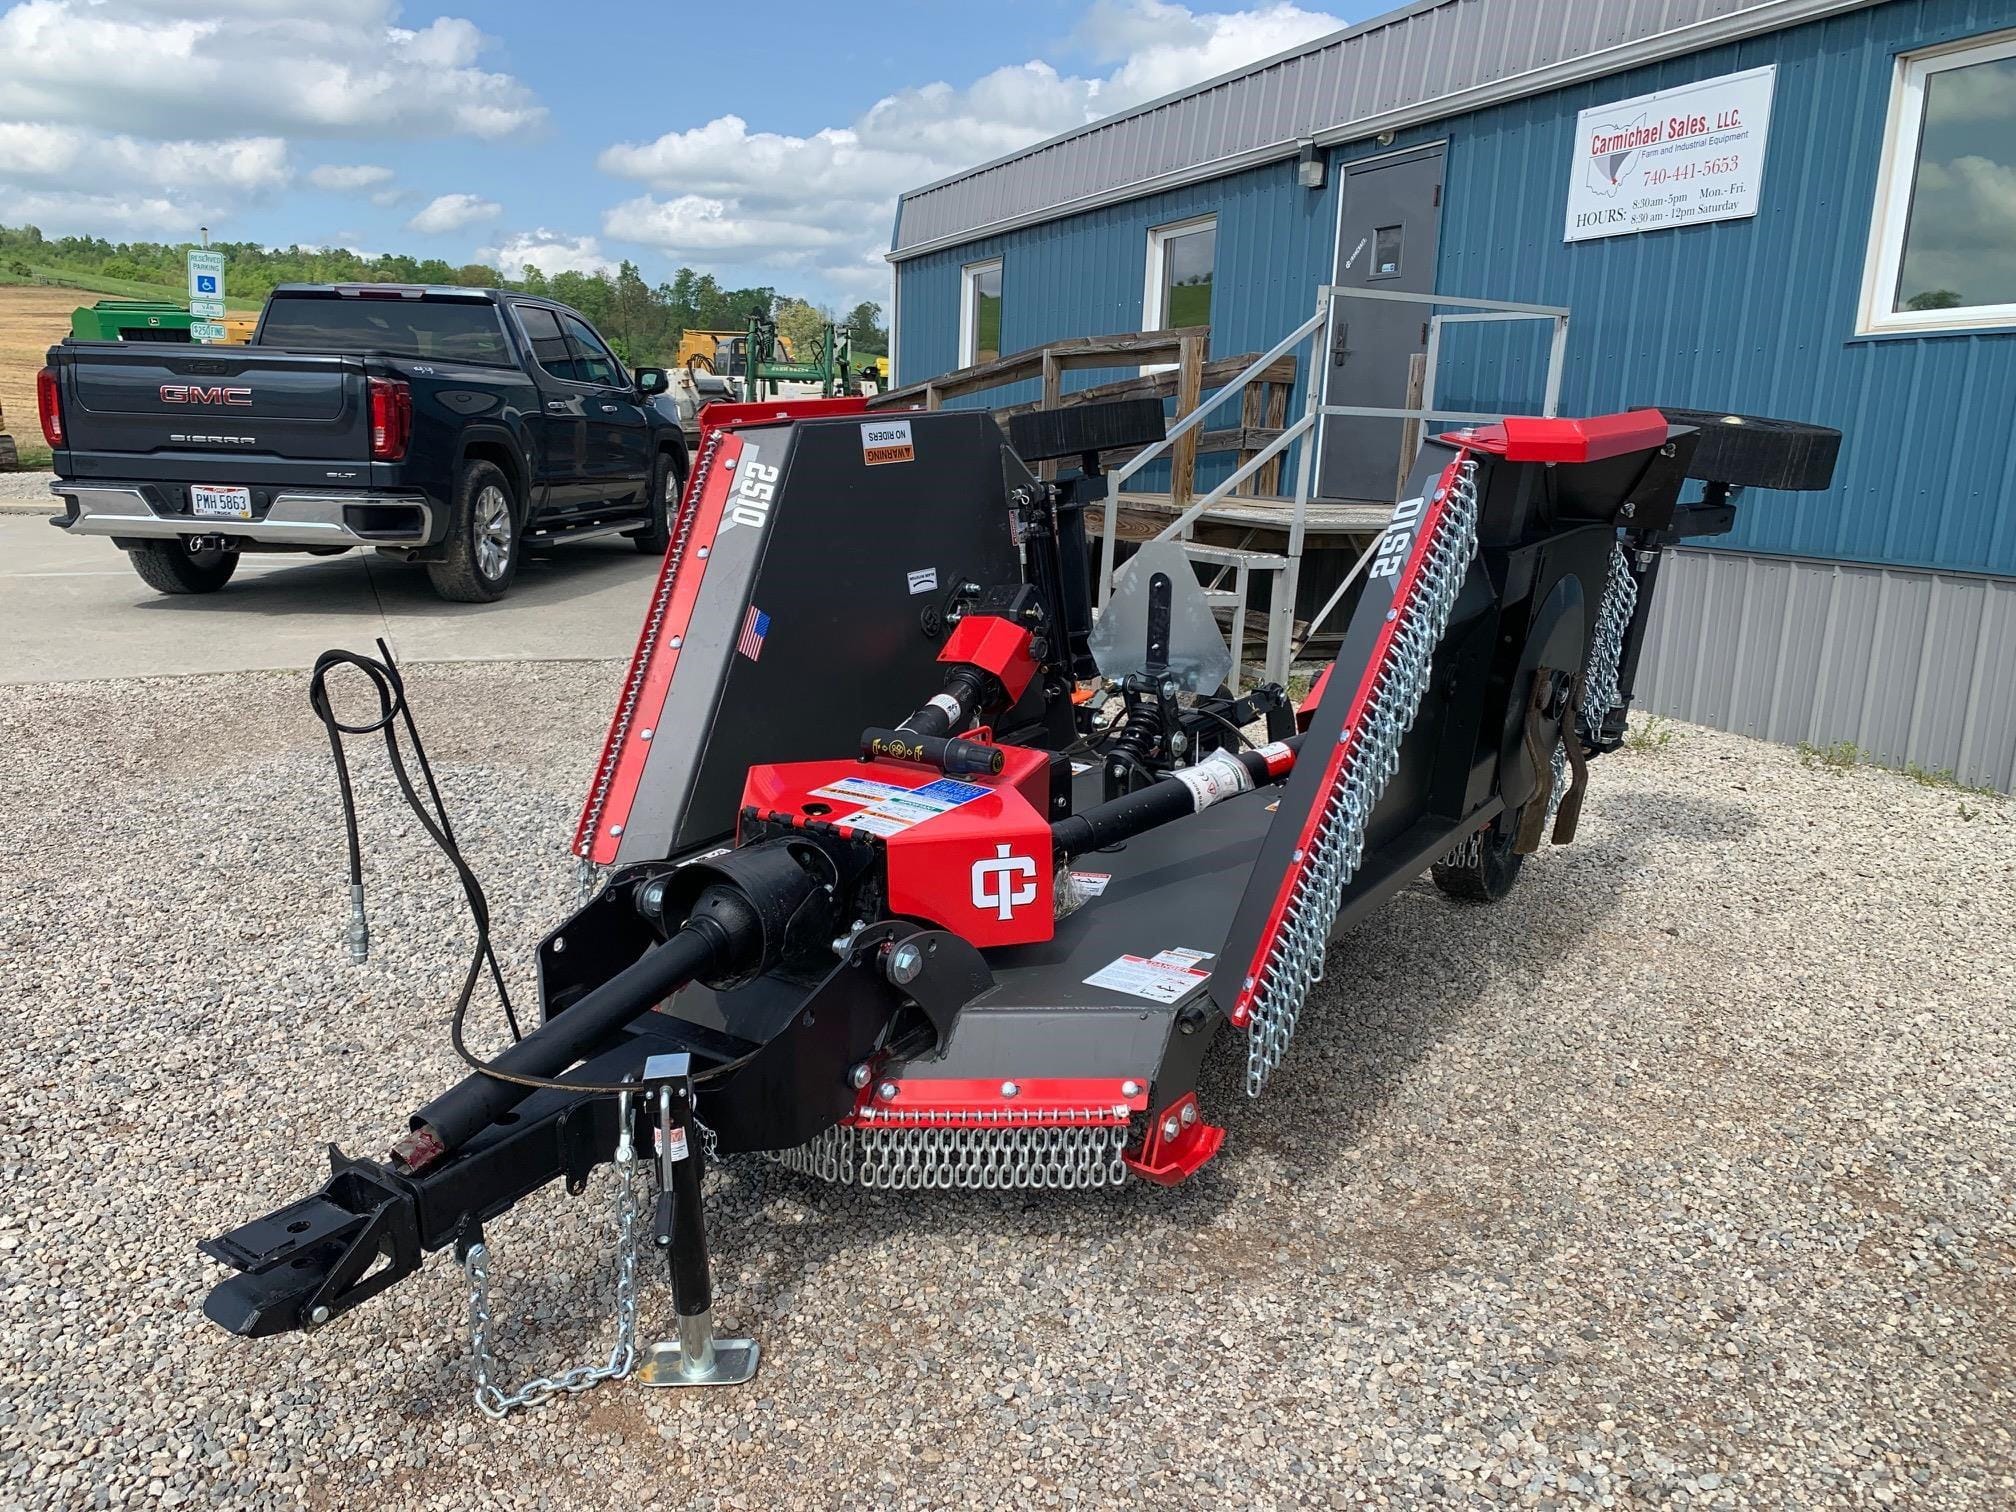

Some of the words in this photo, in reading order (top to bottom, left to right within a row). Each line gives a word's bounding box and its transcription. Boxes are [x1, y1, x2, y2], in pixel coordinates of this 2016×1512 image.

[1592, 120, 1664, 155] Carmichael
[1717, 109, 1741, 129] LLC.
[1641, 149, 1659, 159] Farm
[1660, 145, 1674, 155] and
[1675, 138, 1707, 152] Industrial
[1708, 131, 1750, 146] Equipment
[1643, 155, 1739, 187] 740-441-5653
[1697, 200, 1740, 215] Saturday
[1576, 207, 1627, 227] HOURS:
[190, 254, 221, 264] RESERVED
[192, 263, 220, 272] PARKING
[210, 326, 224, 337] FINE
[160, 385, 253, 406] GMC
[170, 434, 256, 444] SIERRA
[868, 431, 895, 441] RIDERS
[895, 430, 906, 439] NO
[867, 448, 906, 461] WARNING
[196, 493, 217, 509] PMH
[219, 495, 247, 510] 5863
[731, 461, 780, 529] 2510
[1368, 496, 1425, 579] 2510
